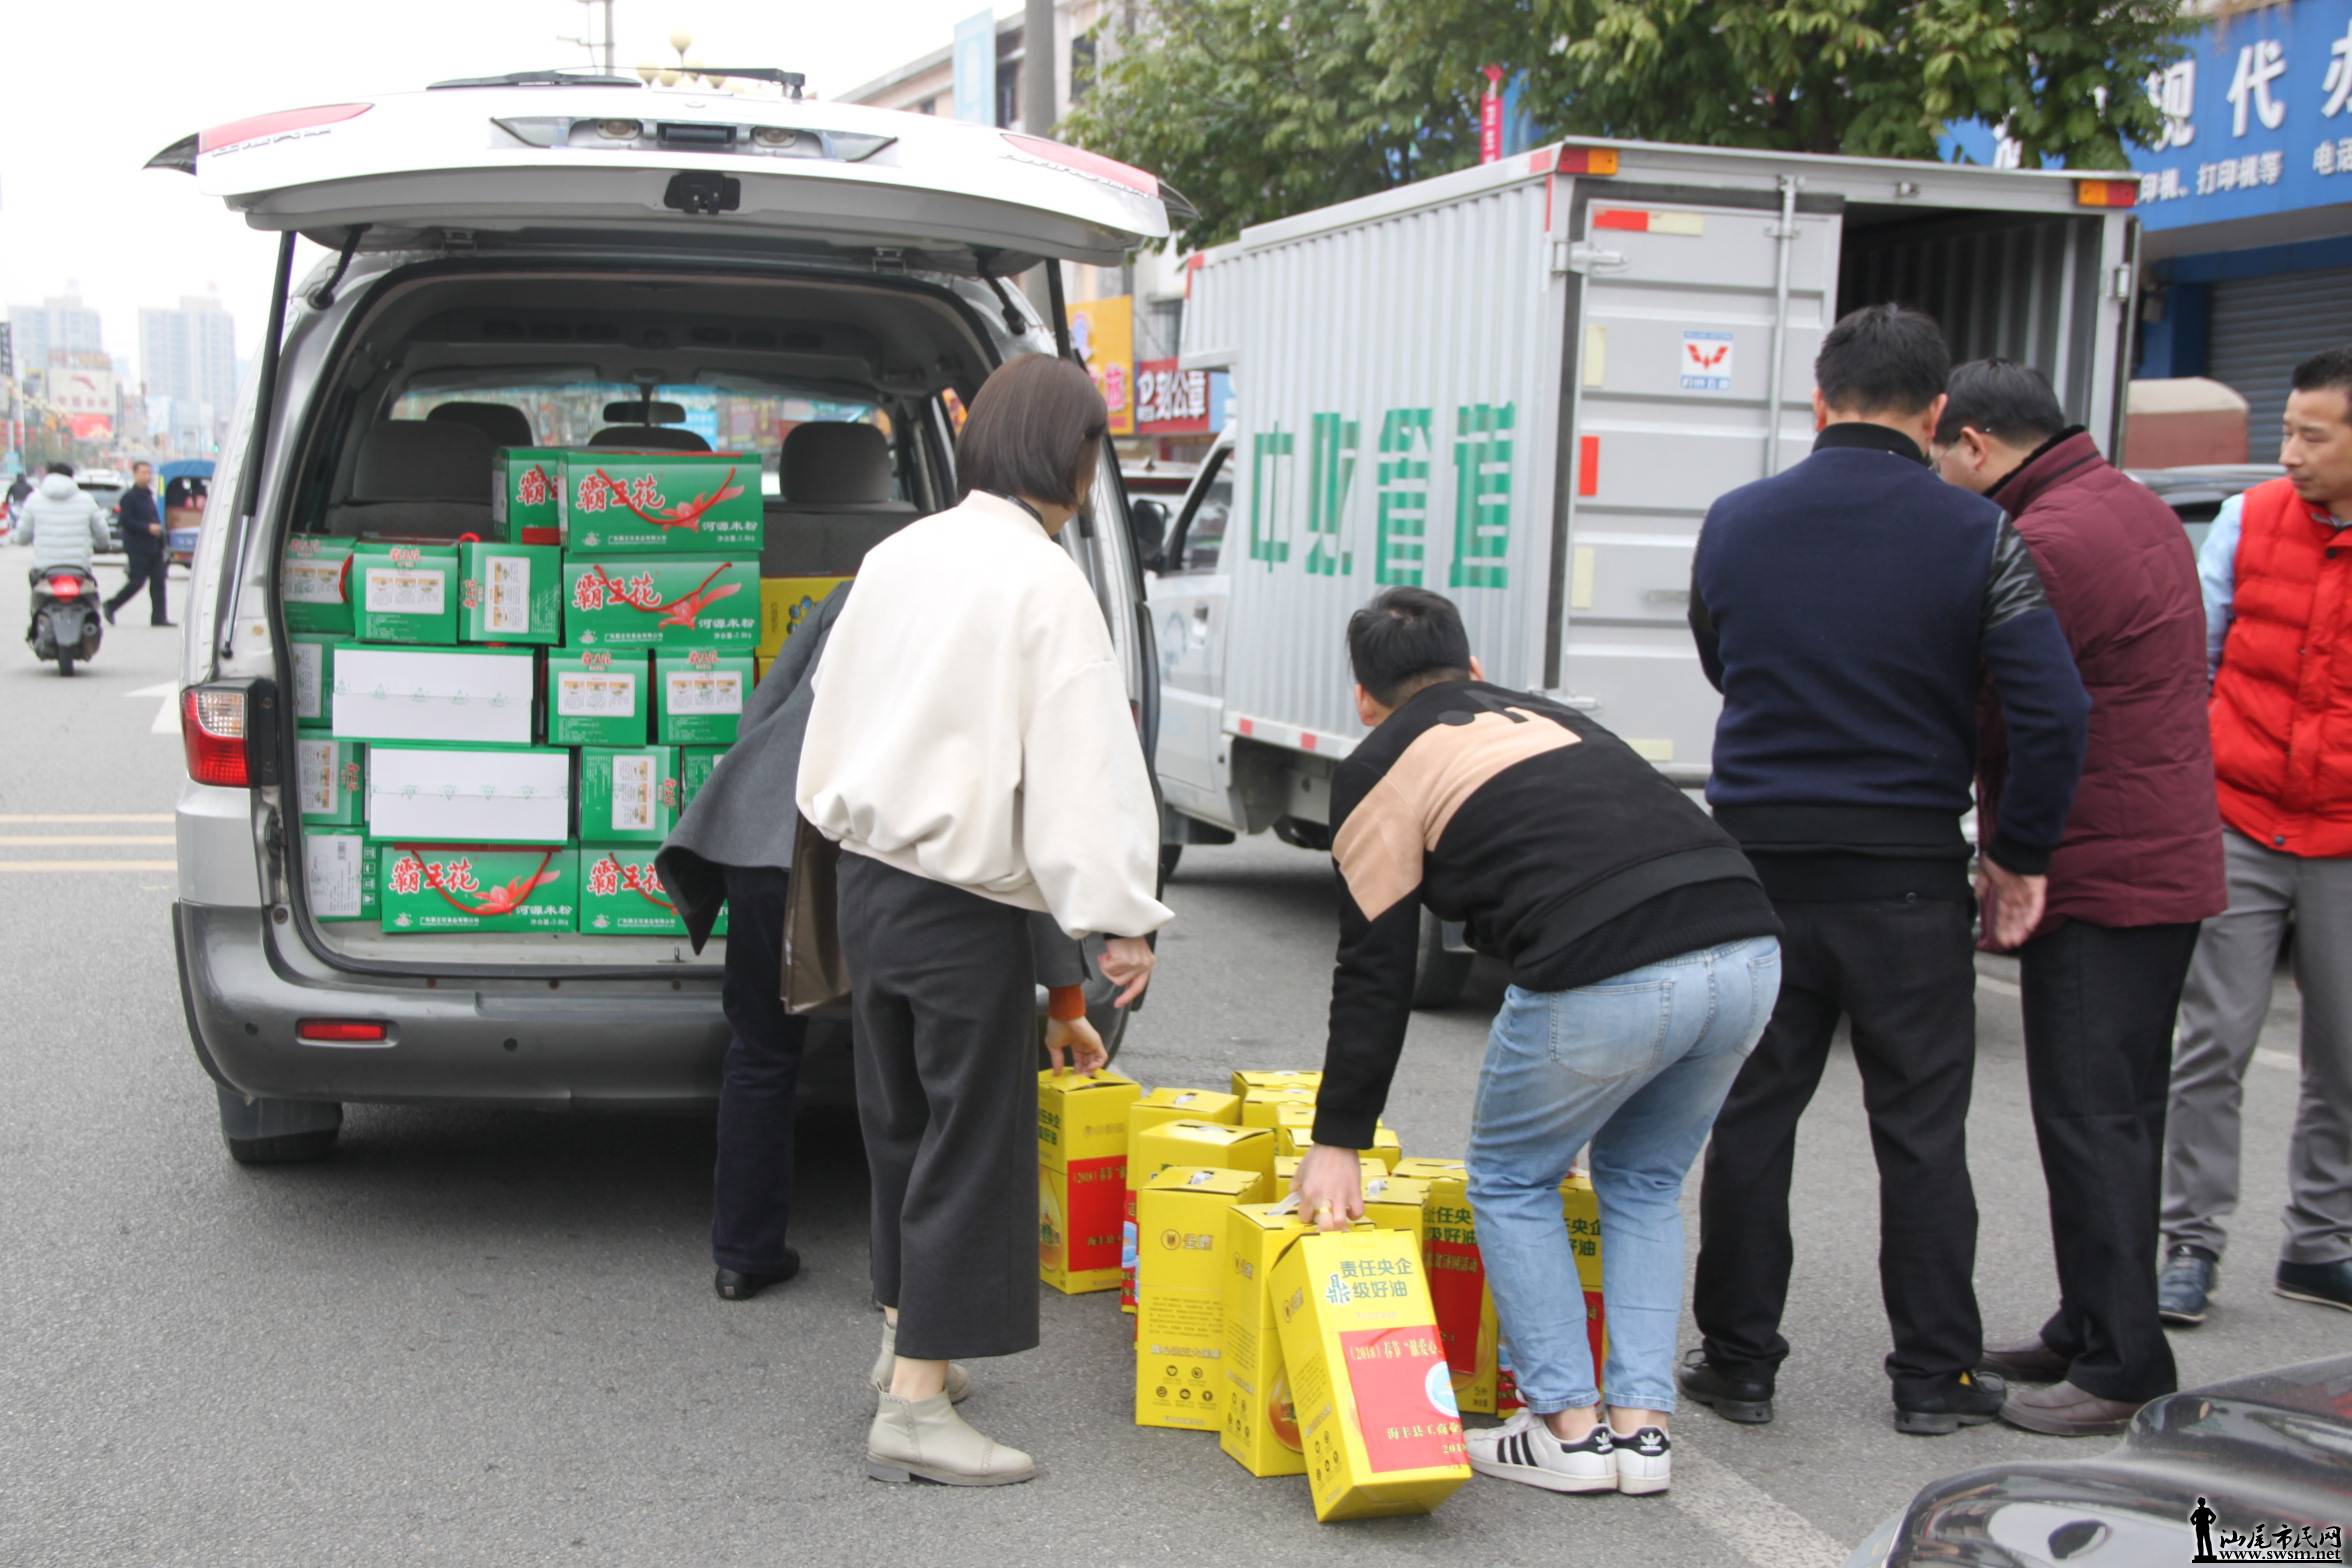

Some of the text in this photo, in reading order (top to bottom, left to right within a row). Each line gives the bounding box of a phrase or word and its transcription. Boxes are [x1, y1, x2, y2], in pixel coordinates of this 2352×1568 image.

[576, 474, 665, 513] 霸王花
[572, 571, 662, 612] 霸王花
[389, 857, 480, 895] 霸王花
[1340, 1257, 1414, 1278] 责任央企
